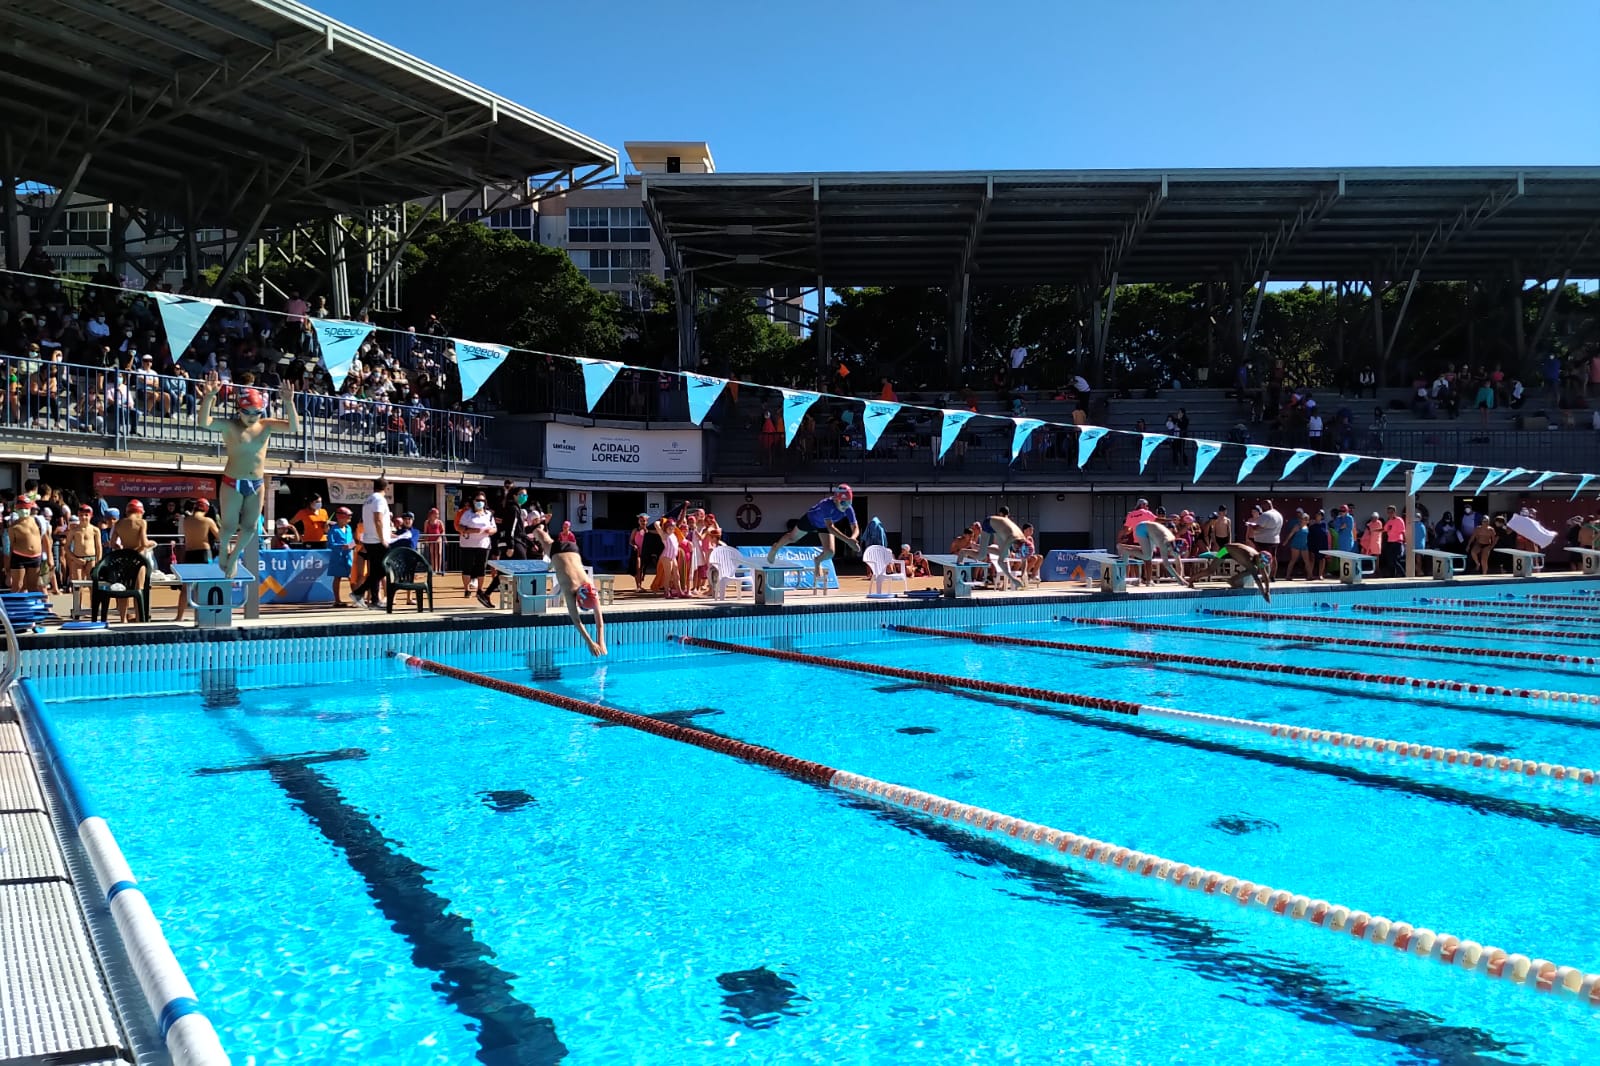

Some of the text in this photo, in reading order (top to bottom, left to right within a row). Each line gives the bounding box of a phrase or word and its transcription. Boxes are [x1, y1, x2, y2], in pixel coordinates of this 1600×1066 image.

[324, 327, 364, 337] speedo
[463, 344, 501, 359] speedo
[592, 442, 640, 453] ACIDALIO
[592, 453, 640, 463] LORENZO
[271, 558, 287, 570] tu
[292, 556, 323, 570] vida
[1343, 562, 1350, 576] 6
[1436, 560, 1442, 573] 7
[1516, 558, 1522, 571] 8
[1585, 557, 1592, 569] 9
[947, 569, 953, 588] 3
[1103, 567, 1111, 584] 4
[530, 579, 537, 596] 1
[757, 574, 763, 595] 2
[207, 586, 224, 614] 0
